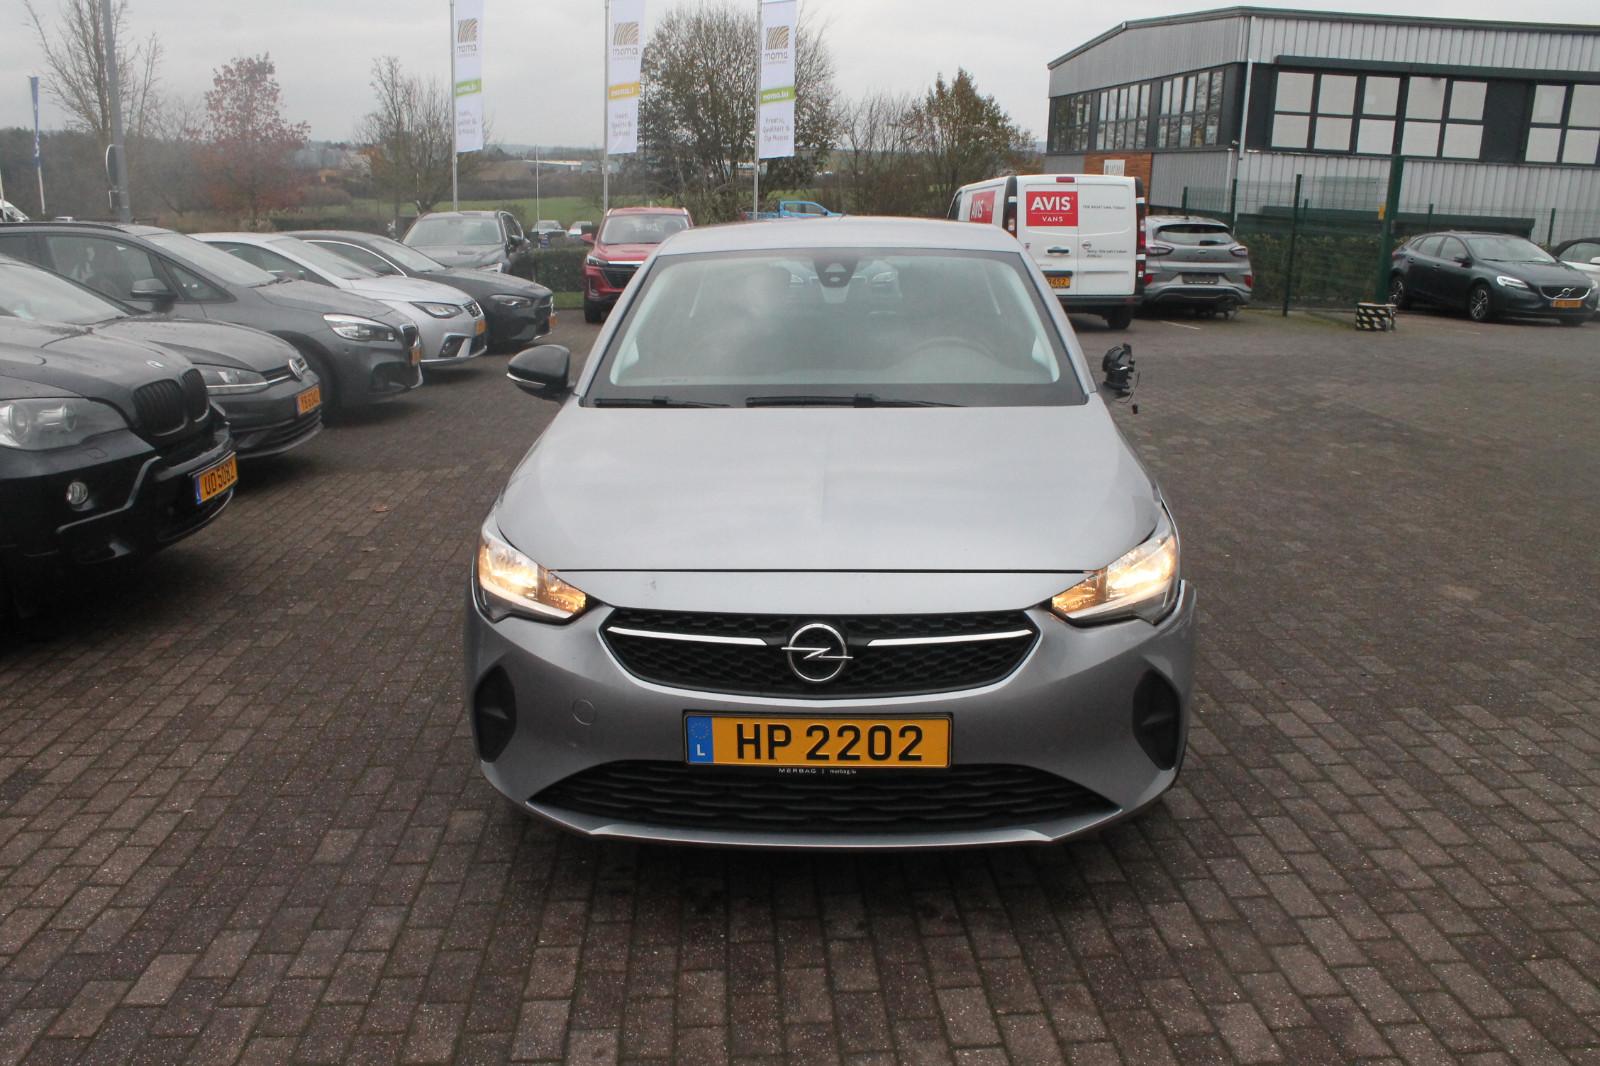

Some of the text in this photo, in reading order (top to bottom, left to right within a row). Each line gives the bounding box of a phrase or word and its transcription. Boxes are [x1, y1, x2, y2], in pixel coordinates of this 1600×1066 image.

[612, 46, 639, 57] moma
[1031, 196, 1071, 211] AVIS
[736, 723, 924, 762] HP 2202
[696, 743, 706, 757] L
